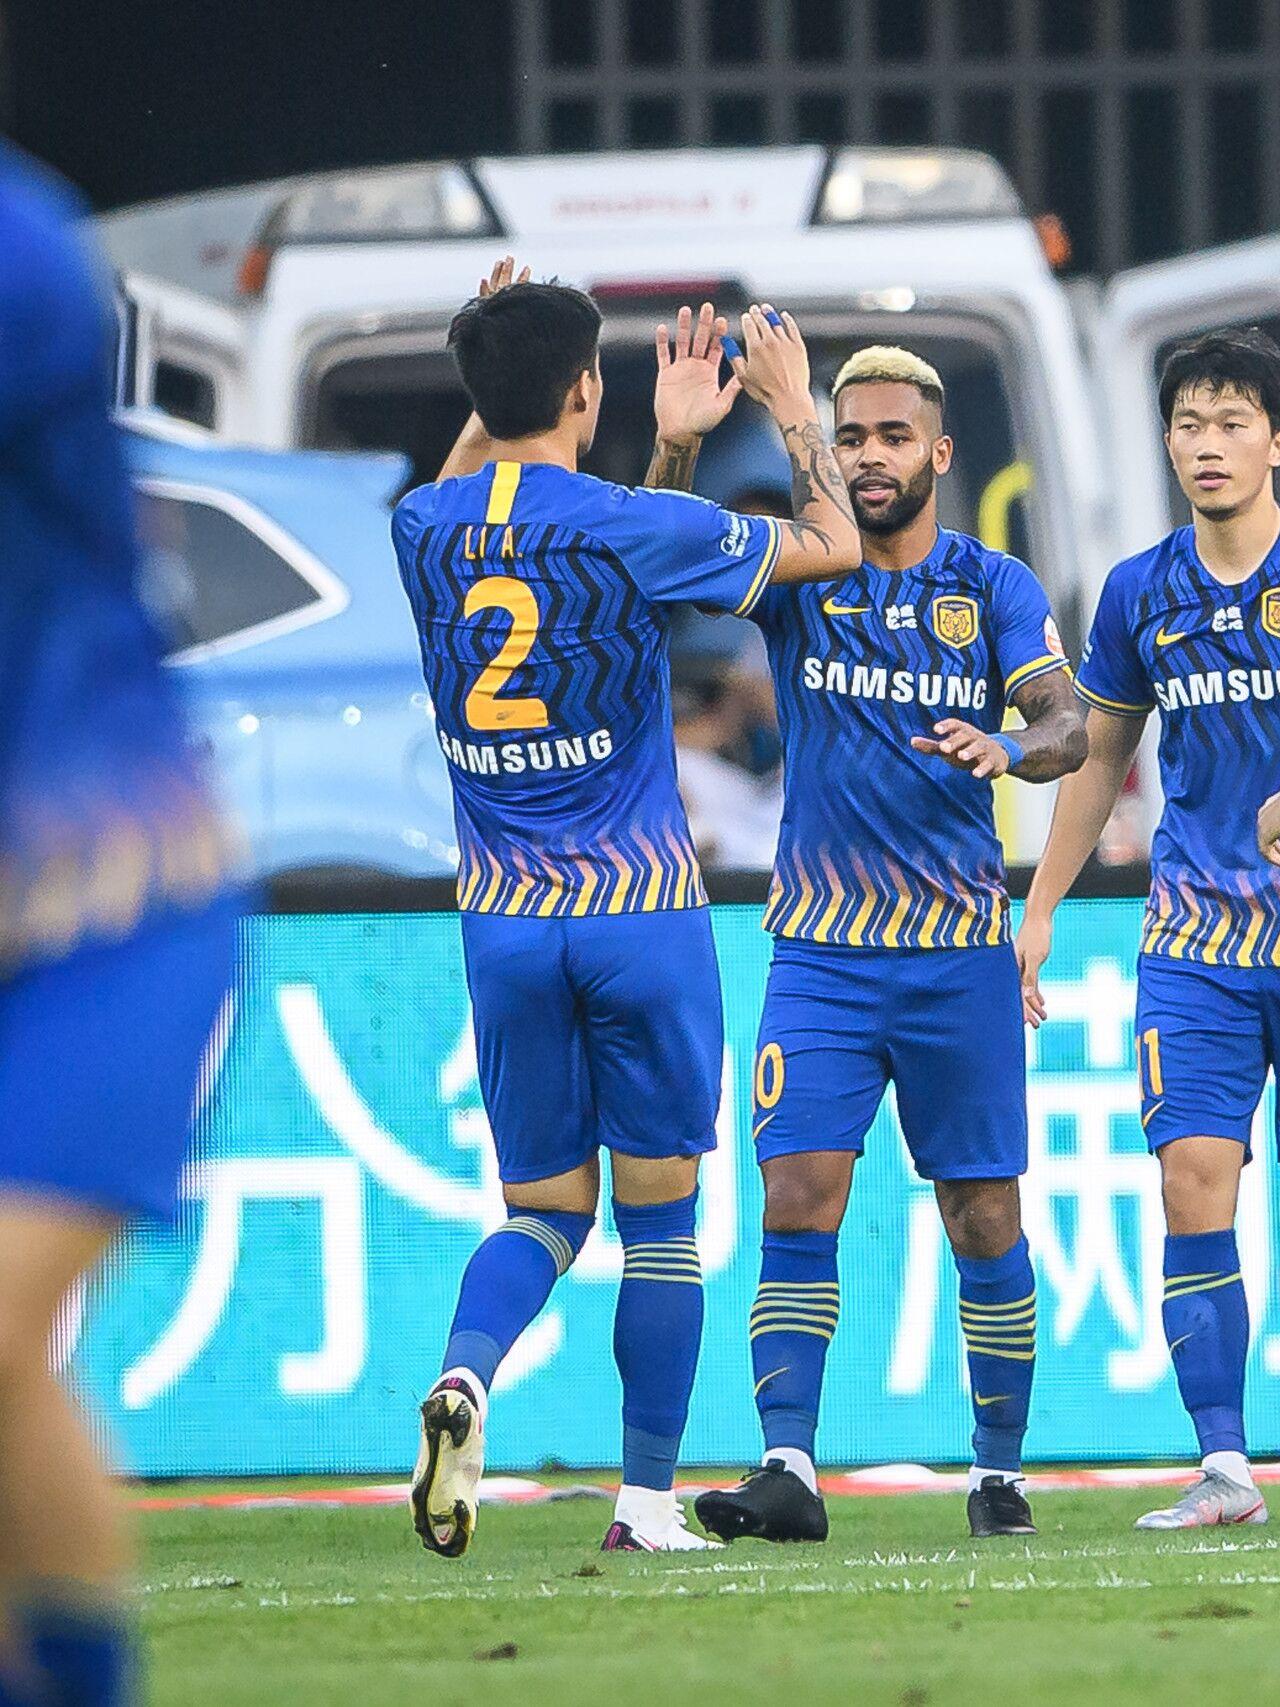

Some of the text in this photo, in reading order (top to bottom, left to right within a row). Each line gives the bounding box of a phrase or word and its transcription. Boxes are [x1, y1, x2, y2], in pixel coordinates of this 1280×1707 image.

[465, 525, 524, 560] LI A.
[464, 576, 549, 730] 2
[804, 657, 987, 710] SAMSUNG
